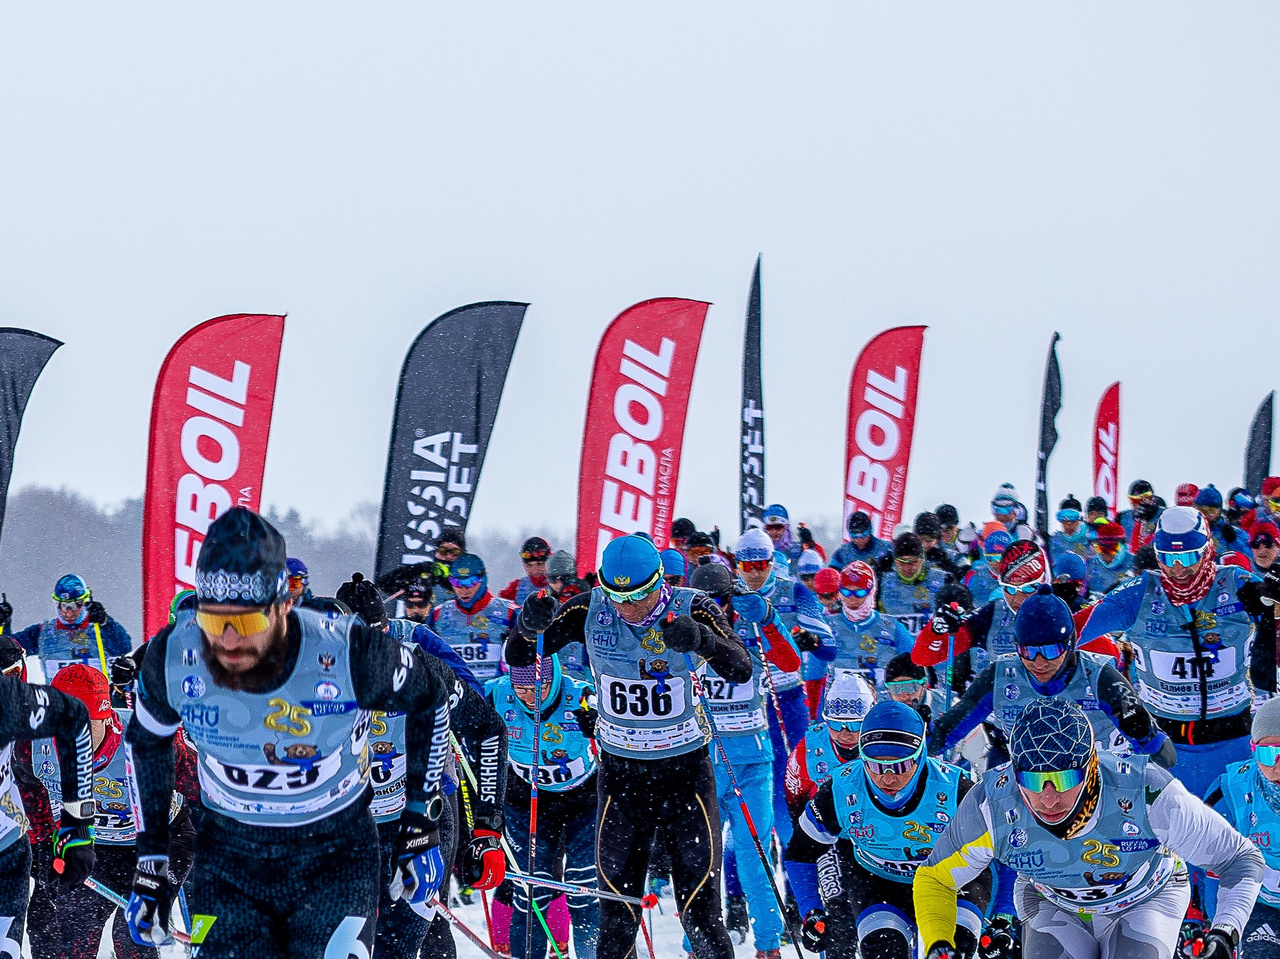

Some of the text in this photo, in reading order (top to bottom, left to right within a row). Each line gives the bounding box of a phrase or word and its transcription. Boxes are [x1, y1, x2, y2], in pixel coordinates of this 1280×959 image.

[175, 360, 251, 594] EBOIL
[1172, 657, 1215, 679] 414
[610, 681, 672, 716] 636
[264, 698, 312, 737] 25
[480, 735, 499, 803] SAKHALIN
[1080, 838, 1120, 867] 25
